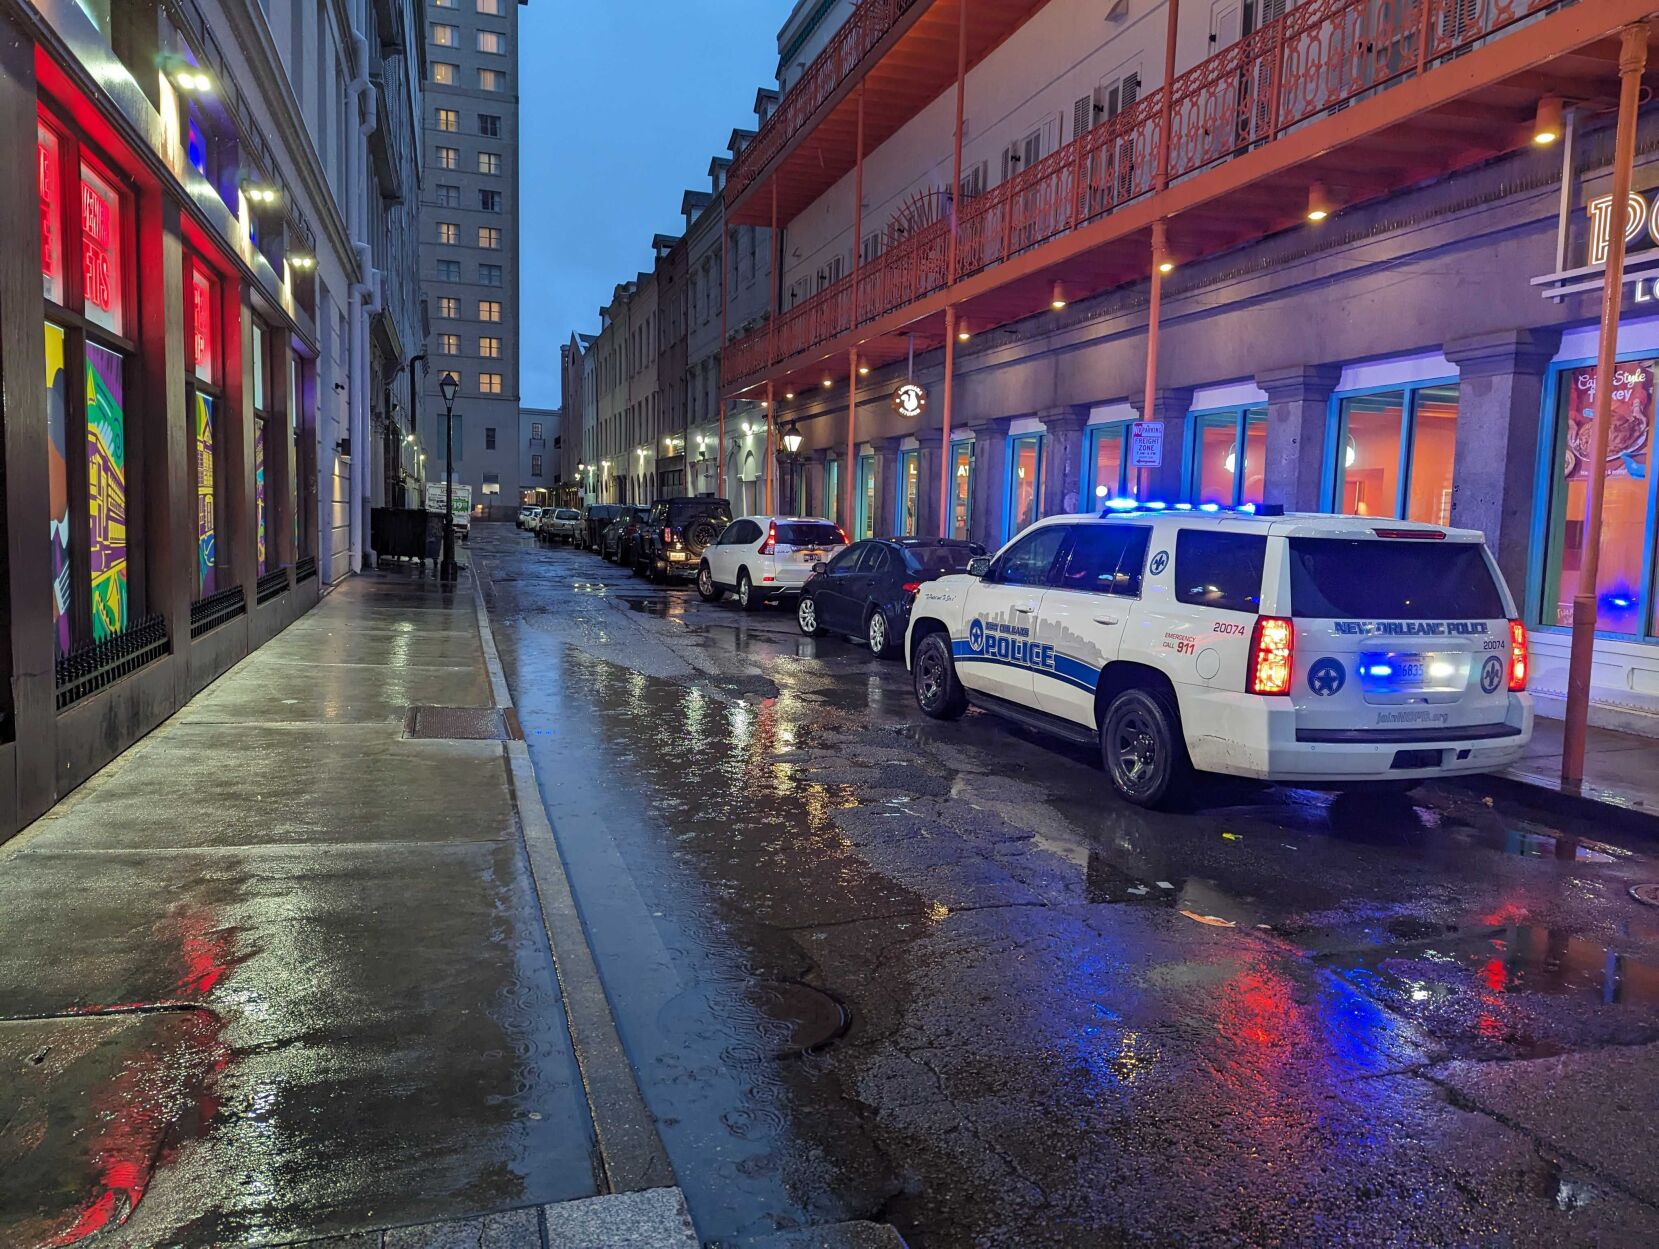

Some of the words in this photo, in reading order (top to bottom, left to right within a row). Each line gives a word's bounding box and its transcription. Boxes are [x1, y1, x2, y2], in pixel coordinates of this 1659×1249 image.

[1138, 444, 1155, 452] ZONE
[999, 623, 1030, 638] ORLEANS
[1213, 622, 1246, 636] 20074
[1334, 621, 1374, 635] NEW
[1375, 621, 1446, 636] ORLEANS
[1447, 622, 1489, 635] POLICE
[1164, 632, 1197, 643] EMERGENCY
[984, 632, 1056, 671] POLICE
[1162, 641, 1175, 649] CALL
[1176, 641, 1196, 655] 911
[1483, 640, 1505, 650] 20074
